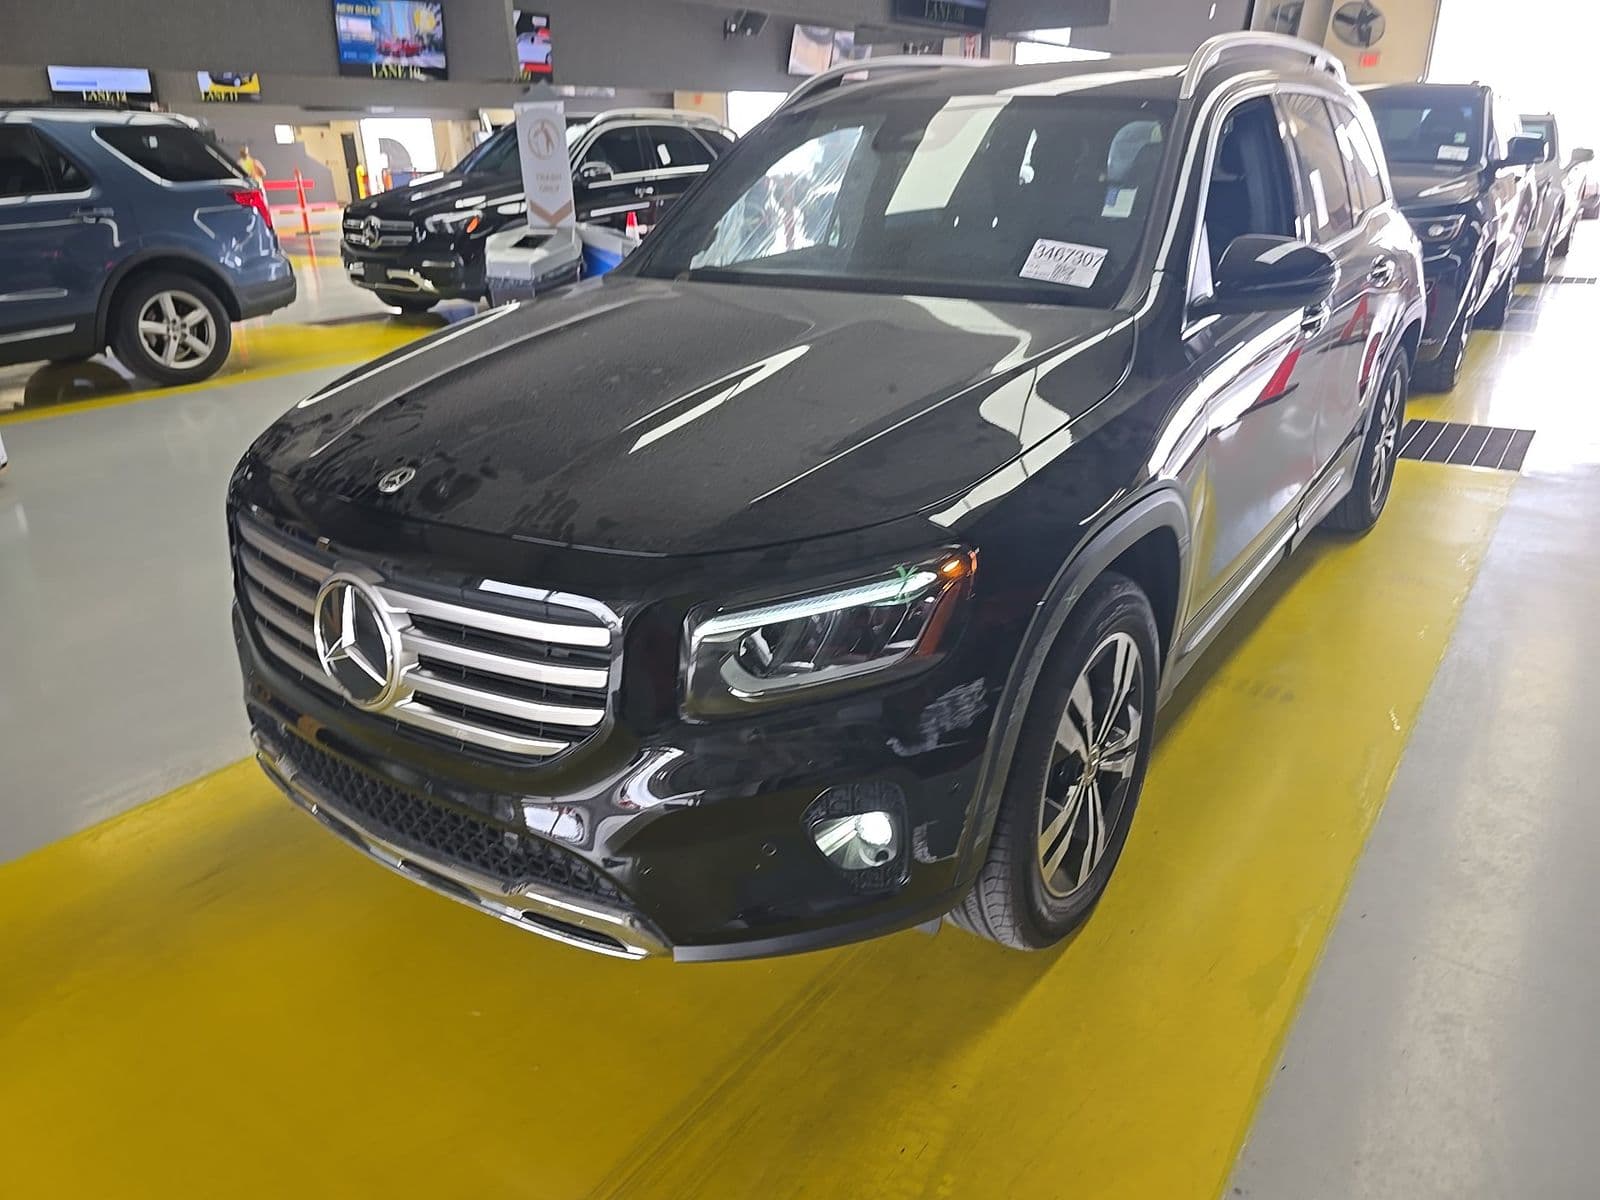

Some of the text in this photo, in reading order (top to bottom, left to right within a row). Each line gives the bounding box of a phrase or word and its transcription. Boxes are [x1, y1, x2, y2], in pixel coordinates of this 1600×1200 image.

[372, 63, 406, 79] LANE
[83, 89, 115, 102] LANE
[201, 89, 229, 102] LANE
[1033, 243, 1106, 268] 3467307
